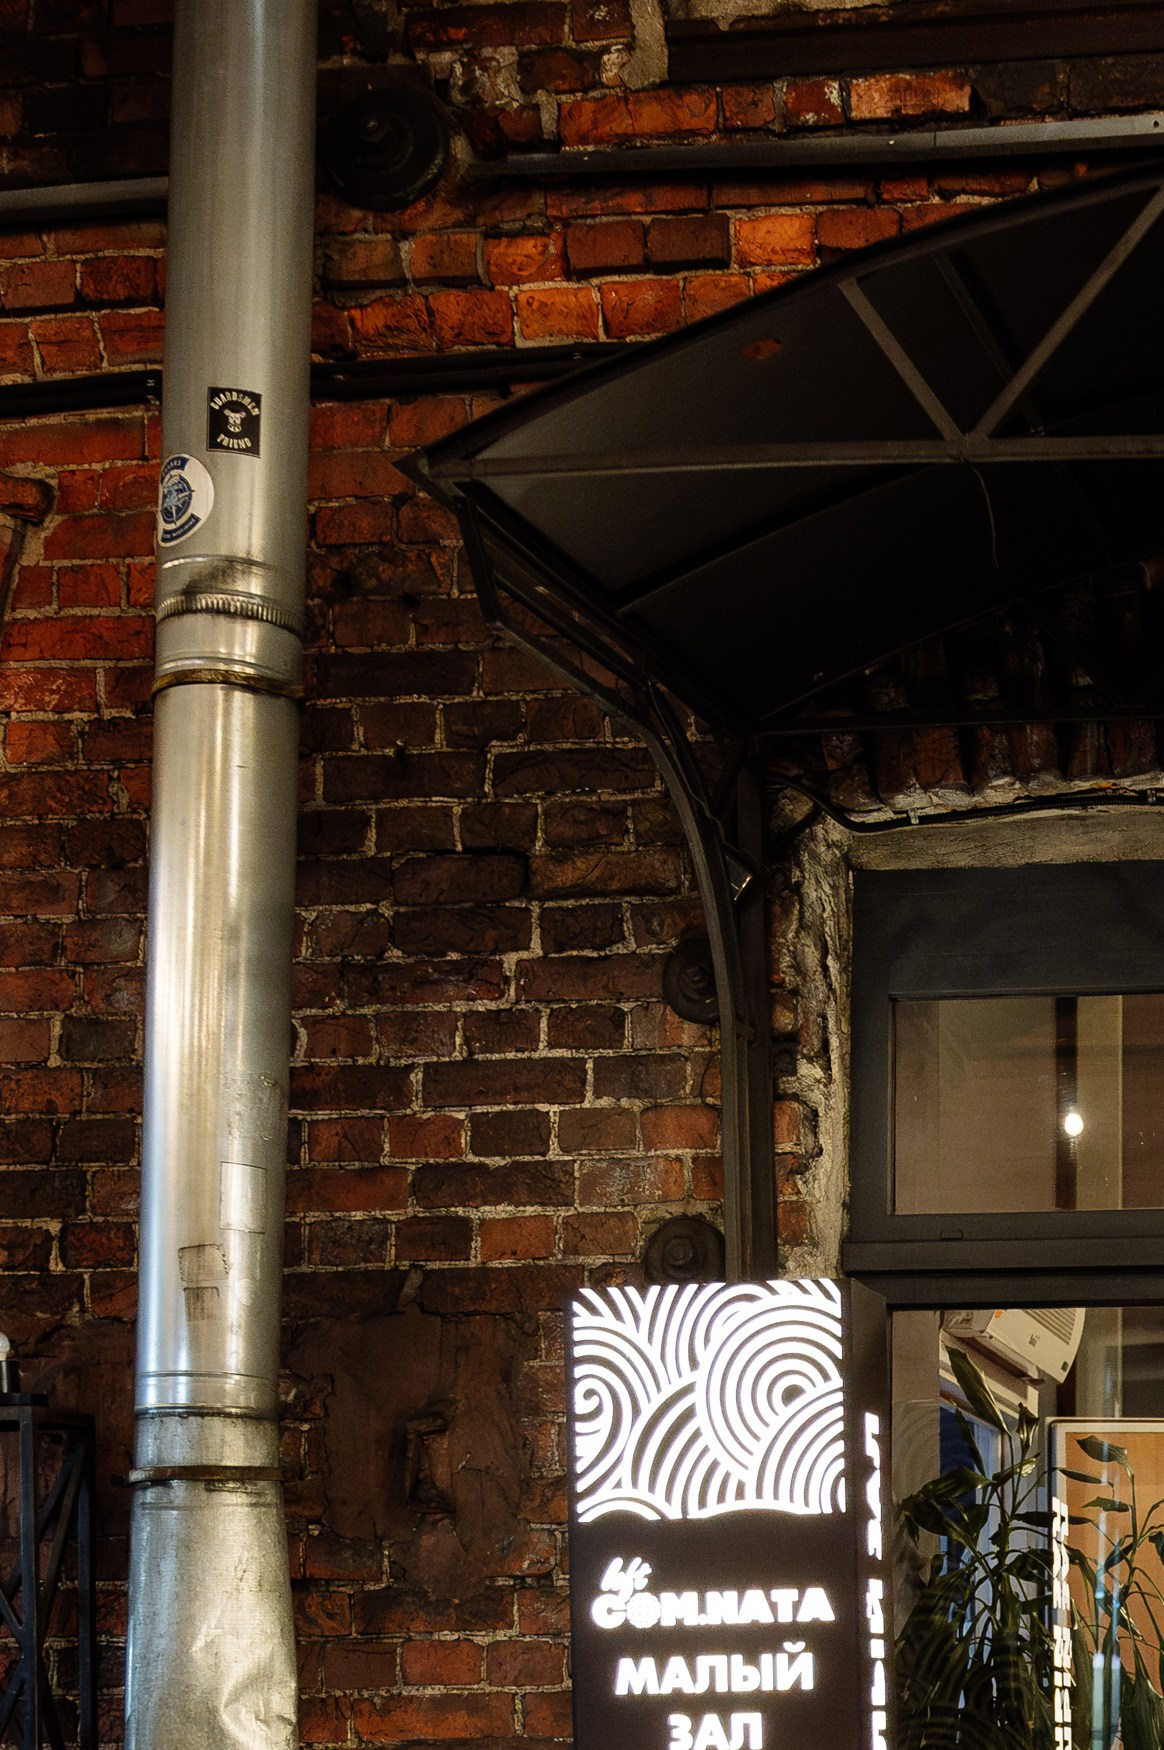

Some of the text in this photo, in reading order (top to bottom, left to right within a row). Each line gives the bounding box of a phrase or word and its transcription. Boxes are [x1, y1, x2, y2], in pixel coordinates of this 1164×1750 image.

[217, 433, 252, 449] FRIEND
[864, 1412, 882, 1561] ЗАЛ
[615, 1641, 814, 1696] МАЛЫЙ
